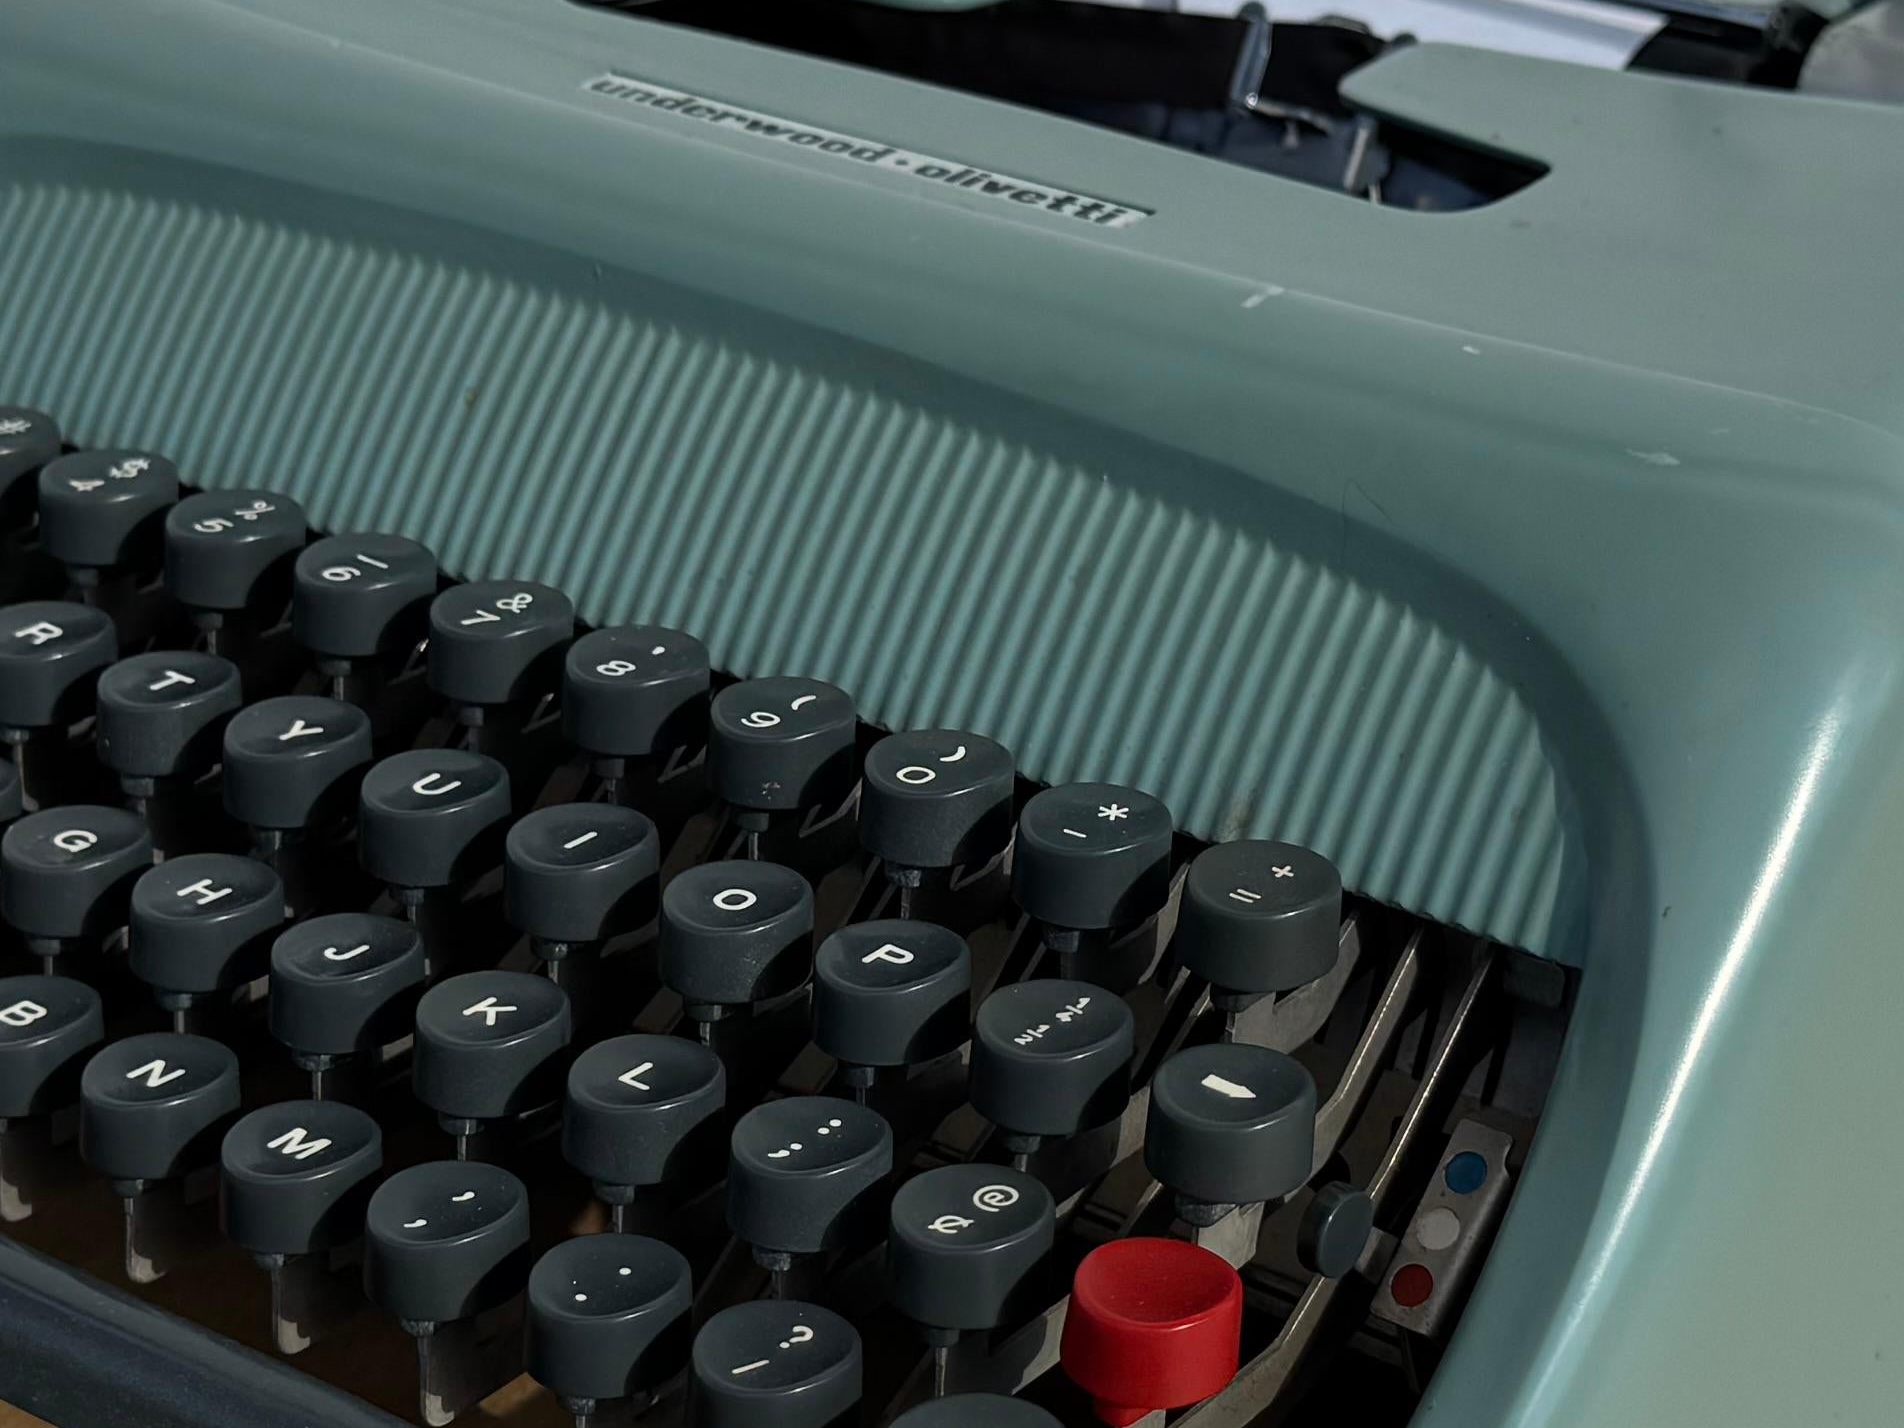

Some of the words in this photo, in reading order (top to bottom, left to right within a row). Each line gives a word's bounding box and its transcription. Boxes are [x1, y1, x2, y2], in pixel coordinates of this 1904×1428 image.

[591, 79, 896, 163] underwood
[913, 163, 1127, 224] olivetti
[68, 479, 106, 492] 4
[193, 518, 235, 533] 5
[320, 566, 362, 582] 6
[459, 609, 502, 626] 7
[13, 621, 64, 645] R
[595, 660, 637, 676] 8
[148, 670, 196, 691] T
[277, 719, 325, 741] Y
[739, 711, 782, 728] 9
[411, 772, 463, 795] U
[52, 829, 99, 853] G
[562, 831, 599, 849] I
[175, 878, 234, 905] H
[711, 888, 758, 911] O
[322, 944, 371, 961] J
[860, 943, 916, 964] P
[461, 996, 519, 1026] K
[125, 1059, 187, 1088] N
[616, 1062, 655, 1091] L
[265, 1127, 333, 1160] M
